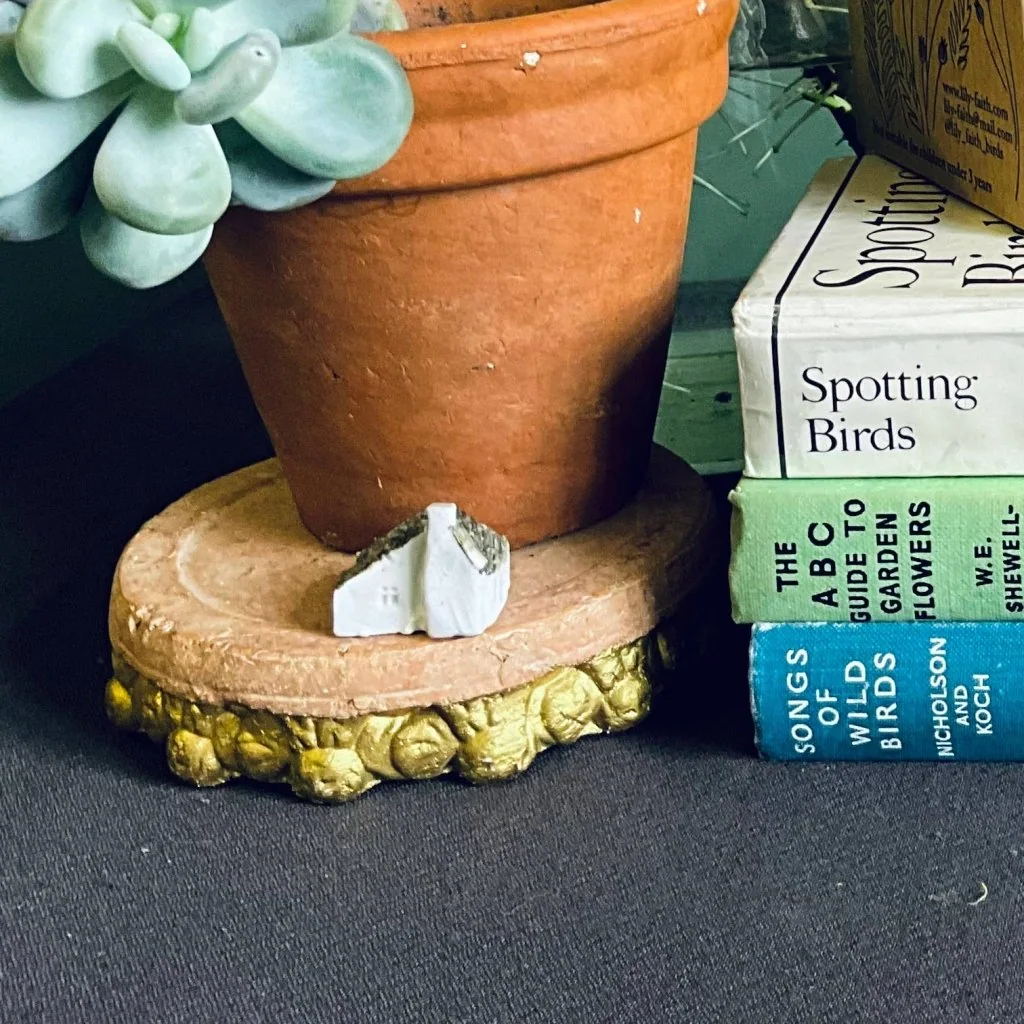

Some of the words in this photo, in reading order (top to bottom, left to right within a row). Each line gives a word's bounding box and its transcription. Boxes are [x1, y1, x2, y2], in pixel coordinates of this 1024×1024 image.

[812, 170, 957, 289] Spottin
[801, 363, 979, 413] Spotting
[806, 417, 917, 454] Birds
[843, 498, 866, 538] TO
[774, 541, 799, 593] THE
[845, 553, 872, 623] GUIDE
[875, 513, 902, 614] GARDEN
[908, 500, 937, 621] FLOWERS
[1001, 504, 1024, 613] SHEWELL-
[786, 647, 816, 754] SONGS
[815, 688, 840, 726] OF
[844, 659, 872, 746] WILD
[873, 651, 903, 750] BIRDS
[928, 636, 955, 758] NICHOLSON
[953, 684, 970, 727] AND
[972, 673, 993, 735] KOCH
